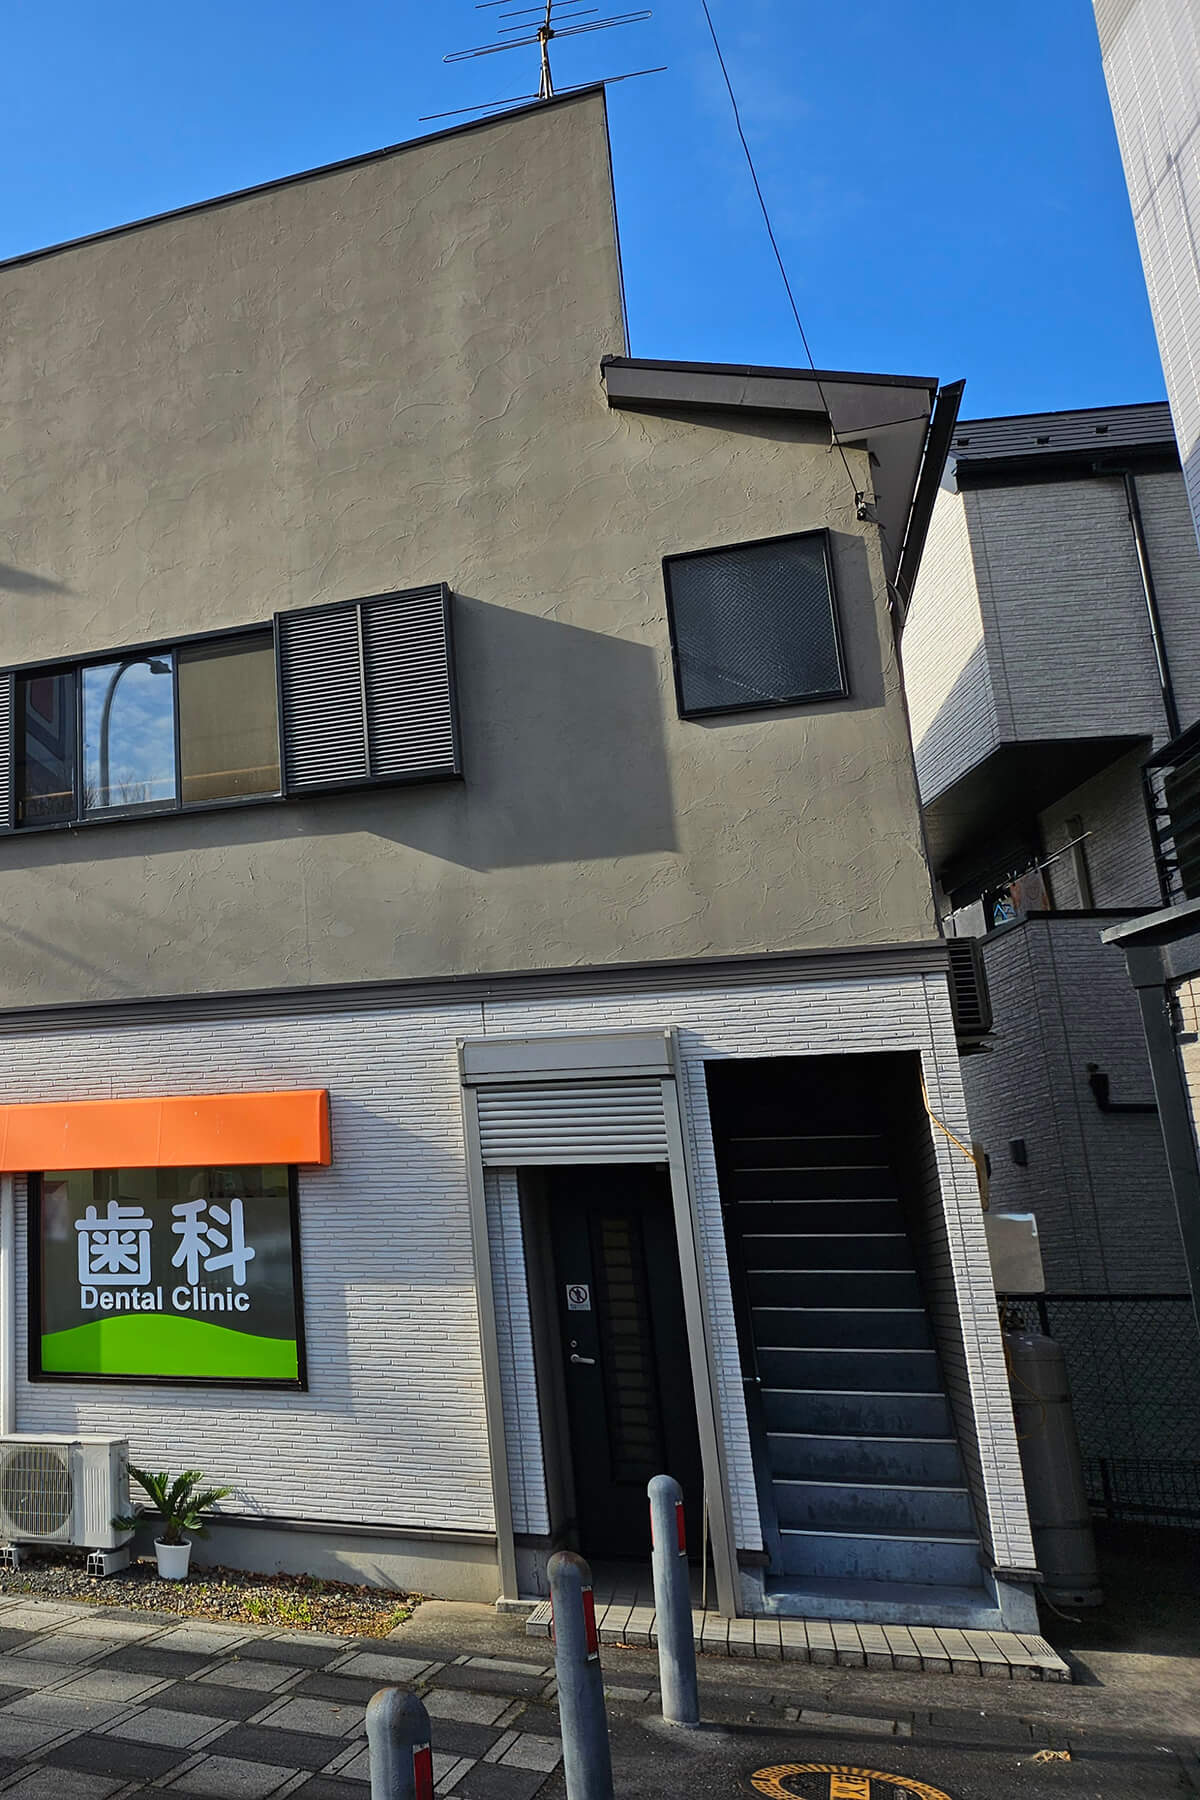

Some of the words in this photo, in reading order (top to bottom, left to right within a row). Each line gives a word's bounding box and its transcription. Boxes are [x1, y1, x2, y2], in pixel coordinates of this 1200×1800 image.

[74, 1198, 255, 1287] 歯科
[80, 1285, 163, 1311] Dental
[172, 1285, 251, 1313] Clinic
